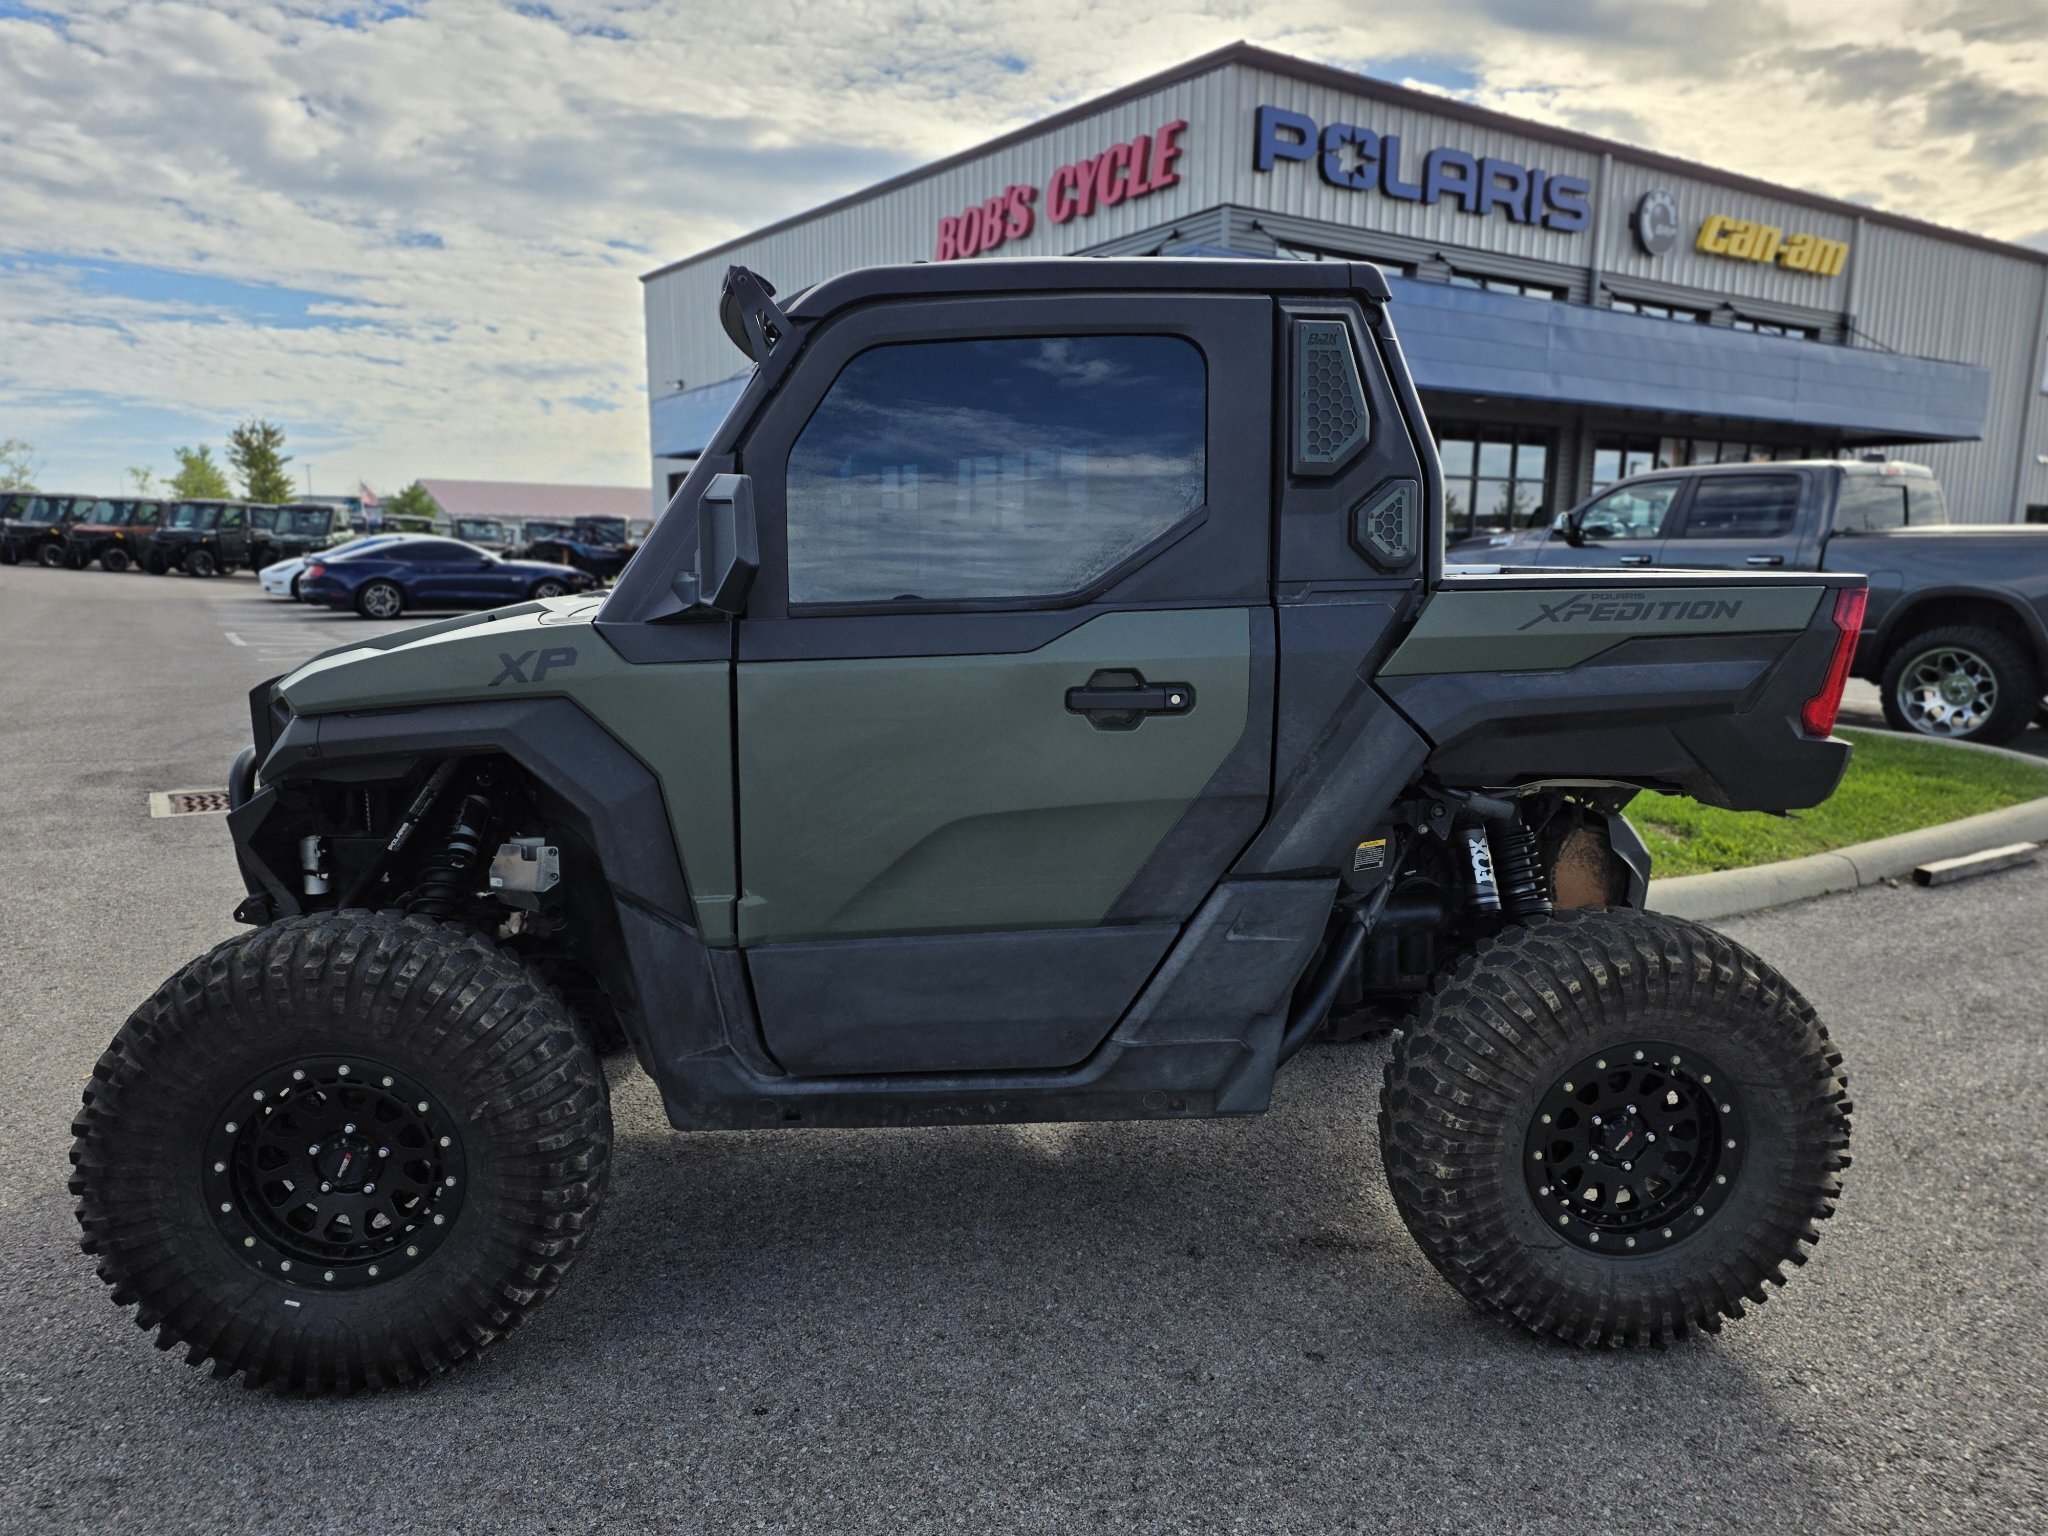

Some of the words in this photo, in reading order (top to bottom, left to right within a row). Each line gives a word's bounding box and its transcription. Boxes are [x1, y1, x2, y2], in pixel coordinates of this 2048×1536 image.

[936, 183, 1038, 261] BOB'S
[1046, 119, 1188, 224] CYCLE
[1253, 105, 1592, 232] POLARIS
[1516, 594, 1743, 630] XPEDITION
[1590, 592, 1646, 601] POLARIS
[487, 646, 579, 687] XP
[1468, 837, 1494, 884] FOX
